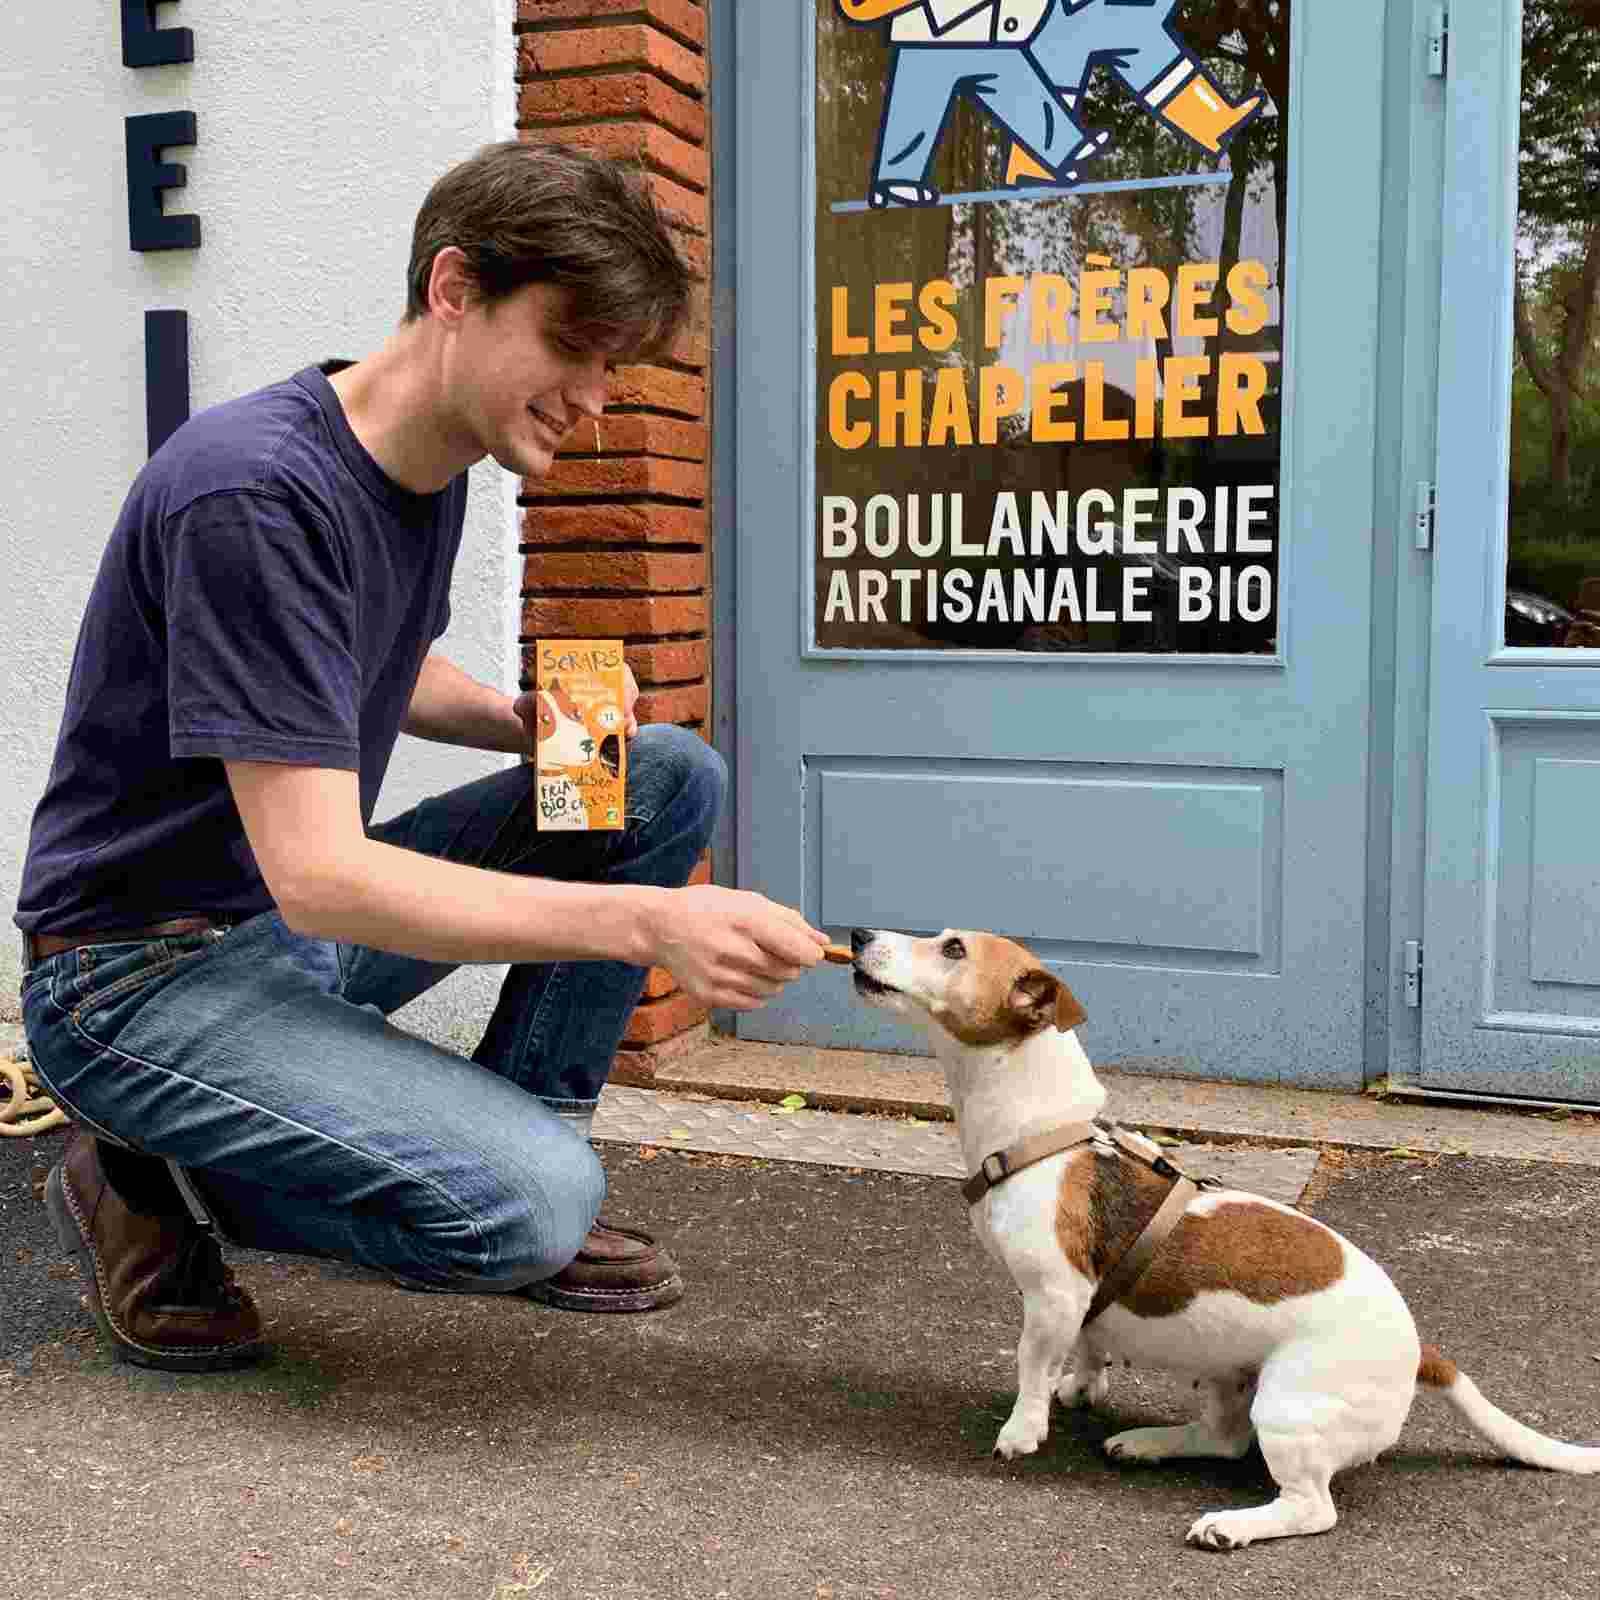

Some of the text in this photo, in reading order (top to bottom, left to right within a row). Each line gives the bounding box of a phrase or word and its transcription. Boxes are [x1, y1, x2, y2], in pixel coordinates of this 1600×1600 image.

[831, 254, 1270, 356] LES FRÈRES
[828, 353, 1269, 450] CHAPELIER
[822, 485, 1275, 558] BOULANGERIE
[823, 565, 1272, 623] ARTISANALE BIO
[540, 797, 567, 818] BIO
